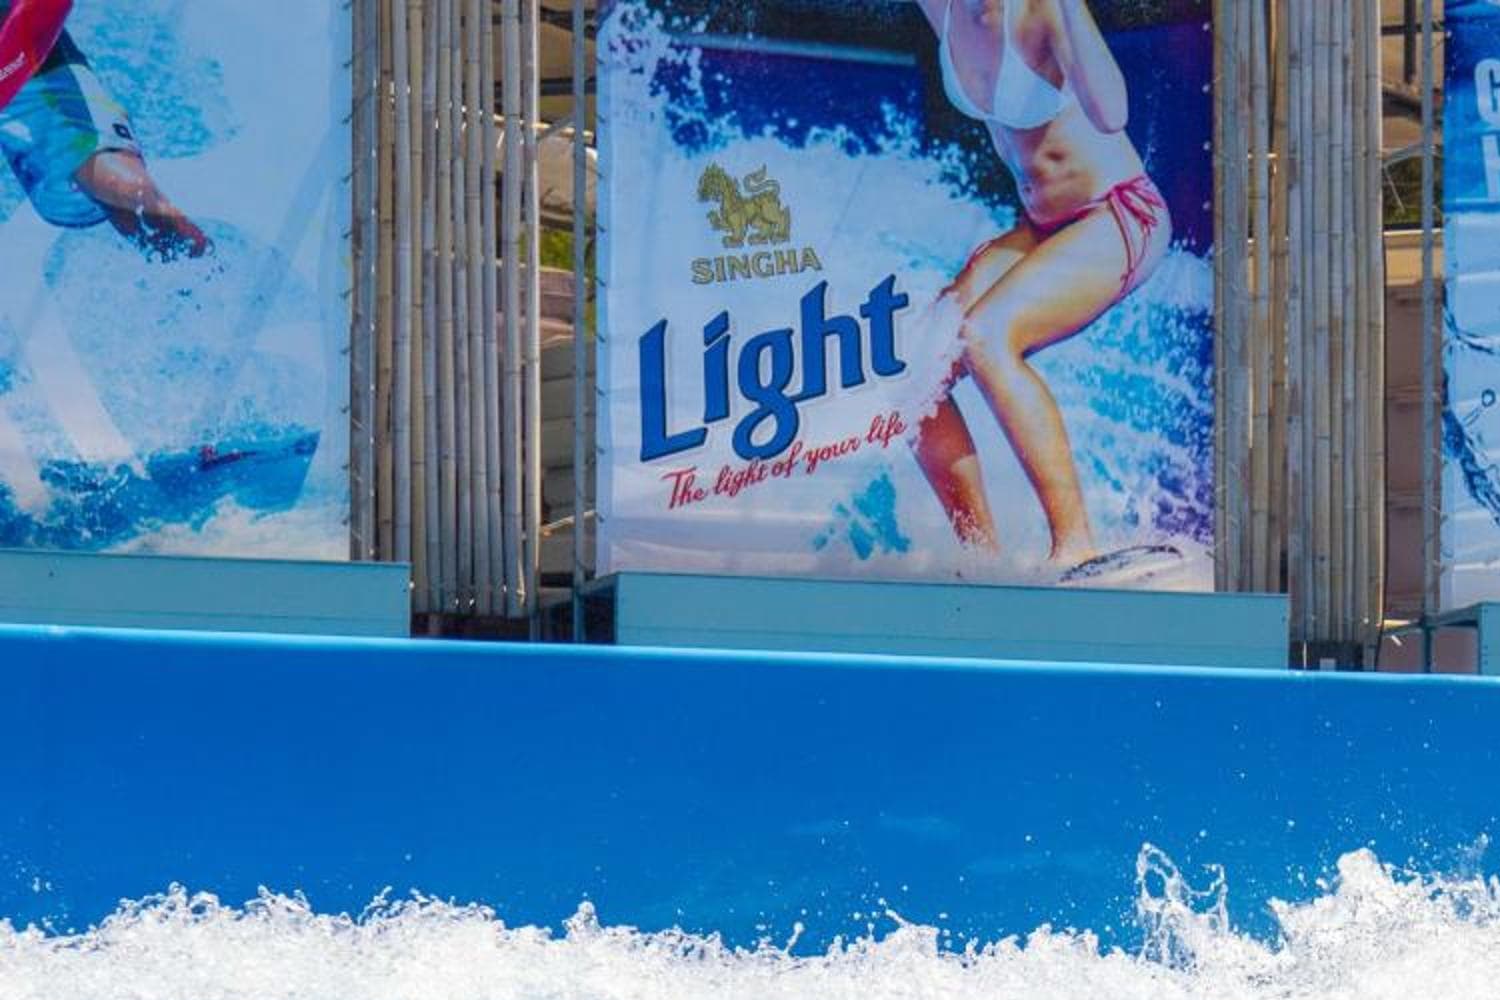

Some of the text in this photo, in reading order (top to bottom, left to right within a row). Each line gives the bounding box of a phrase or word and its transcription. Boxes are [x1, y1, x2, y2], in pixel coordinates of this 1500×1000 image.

[690, 247, 823, 285] SINGHA
[639, 274, 909, 461] Light
[661, 411, 908, 510] The light of your life
